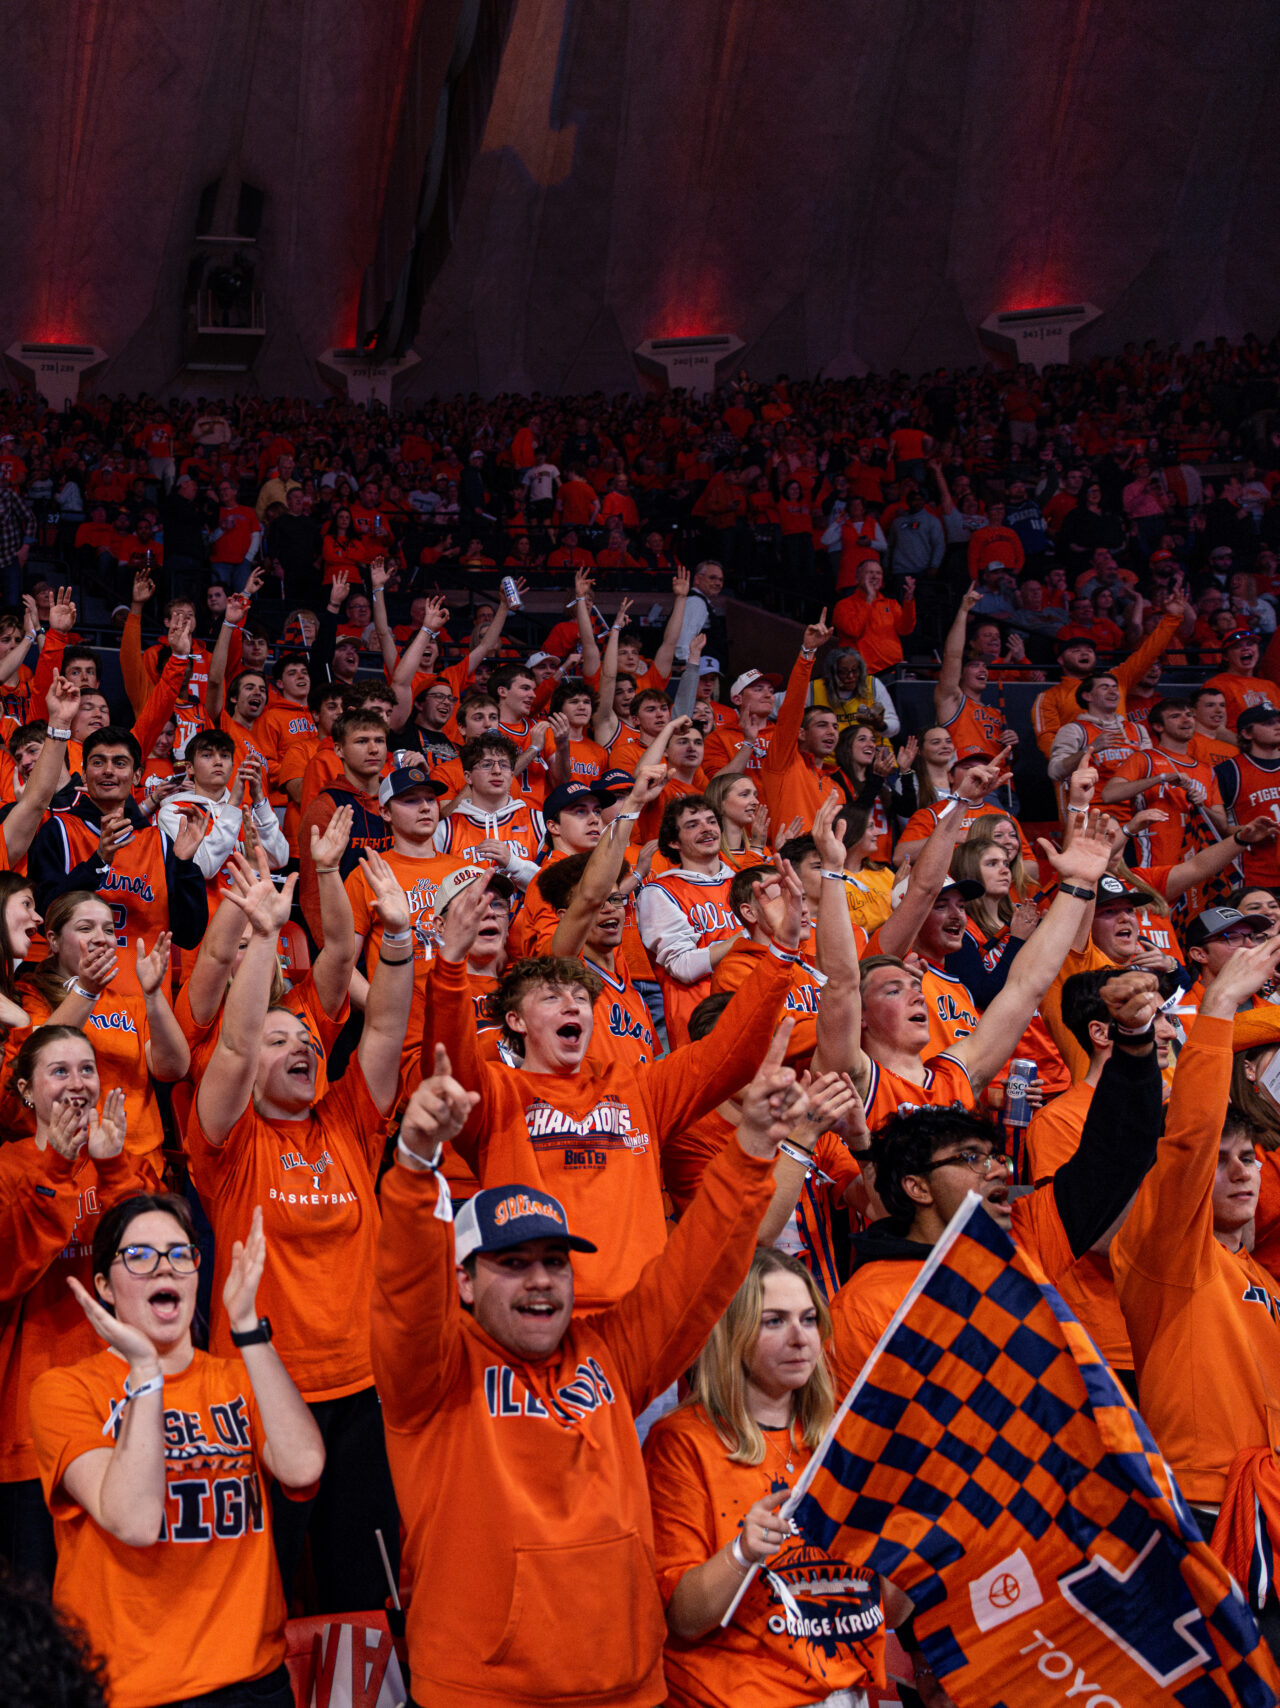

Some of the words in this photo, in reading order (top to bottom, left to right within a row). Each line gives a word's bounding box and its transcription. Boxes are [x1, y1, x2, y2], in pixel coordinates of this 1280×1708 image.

[690, 901, 739, 935] Illin
[494, 1194, 563, 1227] Illinois
[206, 1394, 248, 1449] OF
[766, 1612, 831, 1639] ORANGE
